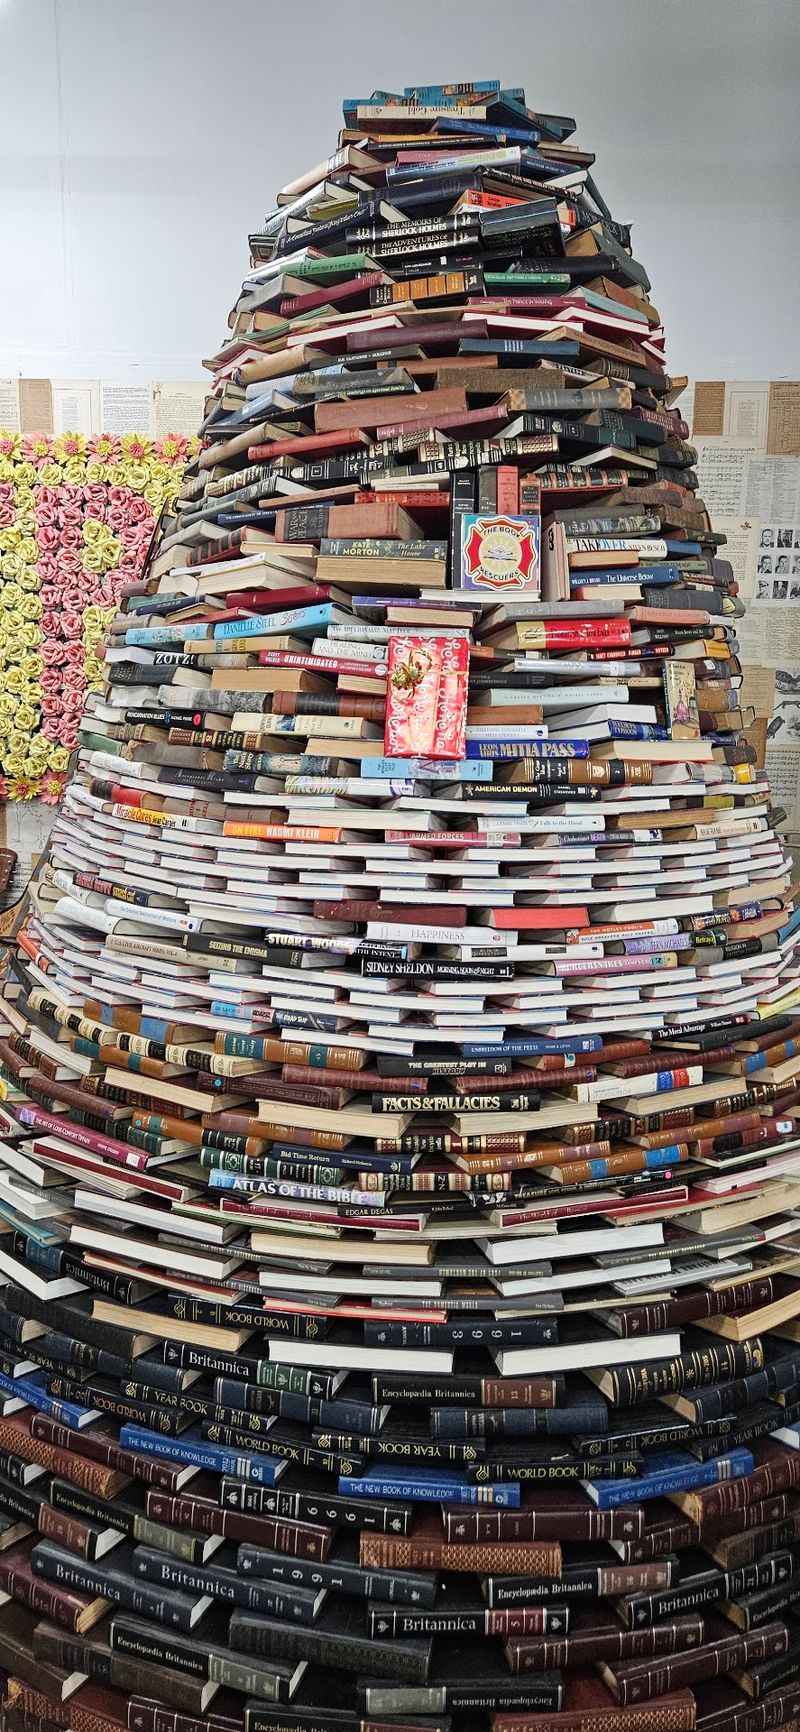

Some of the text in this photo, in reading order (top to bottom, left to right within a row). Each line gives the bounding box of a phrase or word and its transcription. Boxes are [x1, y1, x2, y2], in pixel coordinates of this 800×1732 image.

[401, 219, 431, 228] MEMOIRS
[432, 217, 443, 225] OF
[381, 223, 447, 238] SHERLOCK HOLMES
[380, 240, 448, 256] SHERLOCK HOLMES
[391, 234, 437, 247] ADVENTURES
[484, 526, 521, 538] THE BOOK
[479, 566, 520, 581] RESCUERS
[606, 574, 616, 583] The
[223, 619, 254, 636] DANIELLE
[254, 617, 277, 632] STEEL
[155, 653, 194, 665] ZOTZ!
[283, 654, 338, 669] UNINTIMIDATED
[500, 743, 539, 757] MITIA
[541, 743, 576, 758] PASS
[475, 785, 538, 793] AMERICAN DEMON
[266, 826, 293, 838] NAOMI
[294, 828, 319, 838] KLEIN
[267, 934, 307, 948] STUART
[411, 929, 465, 941] HAPPINESS
[208, 940, 269, 958] SEIZING THE ENIGMA
[366, 961, 395, 974] SIDNEY
[395, 962, 434, 975] SHELDON
[480, 966, 495, 975] NIGHT
[657, 1023, 706, 1038] The Moral Advantage
[423, 1061, 459, 1069] GREATEST
[382, 1095, 501, 1112] FACTS & FALLACIES
[52, 1125, 63, 1133] LOUIS
[280, 1150, 292, 1159] Bid
[292, 1151, 307, 1160] Time
[308, 1152, 330, 1162] Return
[232, 1179, 276, 1194] ATLAS
[278, 1184, 299, 1197] OF
[299, 1186, 326, 1200] THE
[345, 1207, 394, 1216] EDGAR DEGAS
[66, 1261, 110, 1293] Britannica
[225, 1310, 289, 1330] WORLD BOOK
[188, 1351, 249, 1376] Britannica
[382, 1389, 476, 1399] Encyclopædia Britannica
[93, 1395, 147, 1423] WORLD BOOK
[154, 1391, 208, 1415] YEAR BOOK
[640, 1426, 704, 1448] WORLD BOOK
[127, 1436, 217, 1467] THE NEW BOOK OF KNOWLEDGE
[235, 1434, 300, 1460] WORLD BOOK
[377, 1442, 442, 1457] YEAR BOOK
[507, 1465, 578, 1479] WORLD BOOK
[350, 1483, 456, 1498] THE NEW BOOK OF KNOWLEDGE
[654, 1484, 664, 1494] OF
[8, 1496, 36, 1520] Britannica
[307, 1506, 375, 1523] 1999
[97, 1509, 129, 1530] Britannica
[56, 1563, 121, 1600] Britannica
[160, 1564, 235, 1599] Britannica
[498, 1582, 593, 1600] Encyclopædia Britannica
[658, 1585, 719, 1614] Britannica
[402, 1616, 477, 1632] Britannica
[164, 1651, 203, 1672] Britannica
[452, 1696, 496, 1706] Britannica
